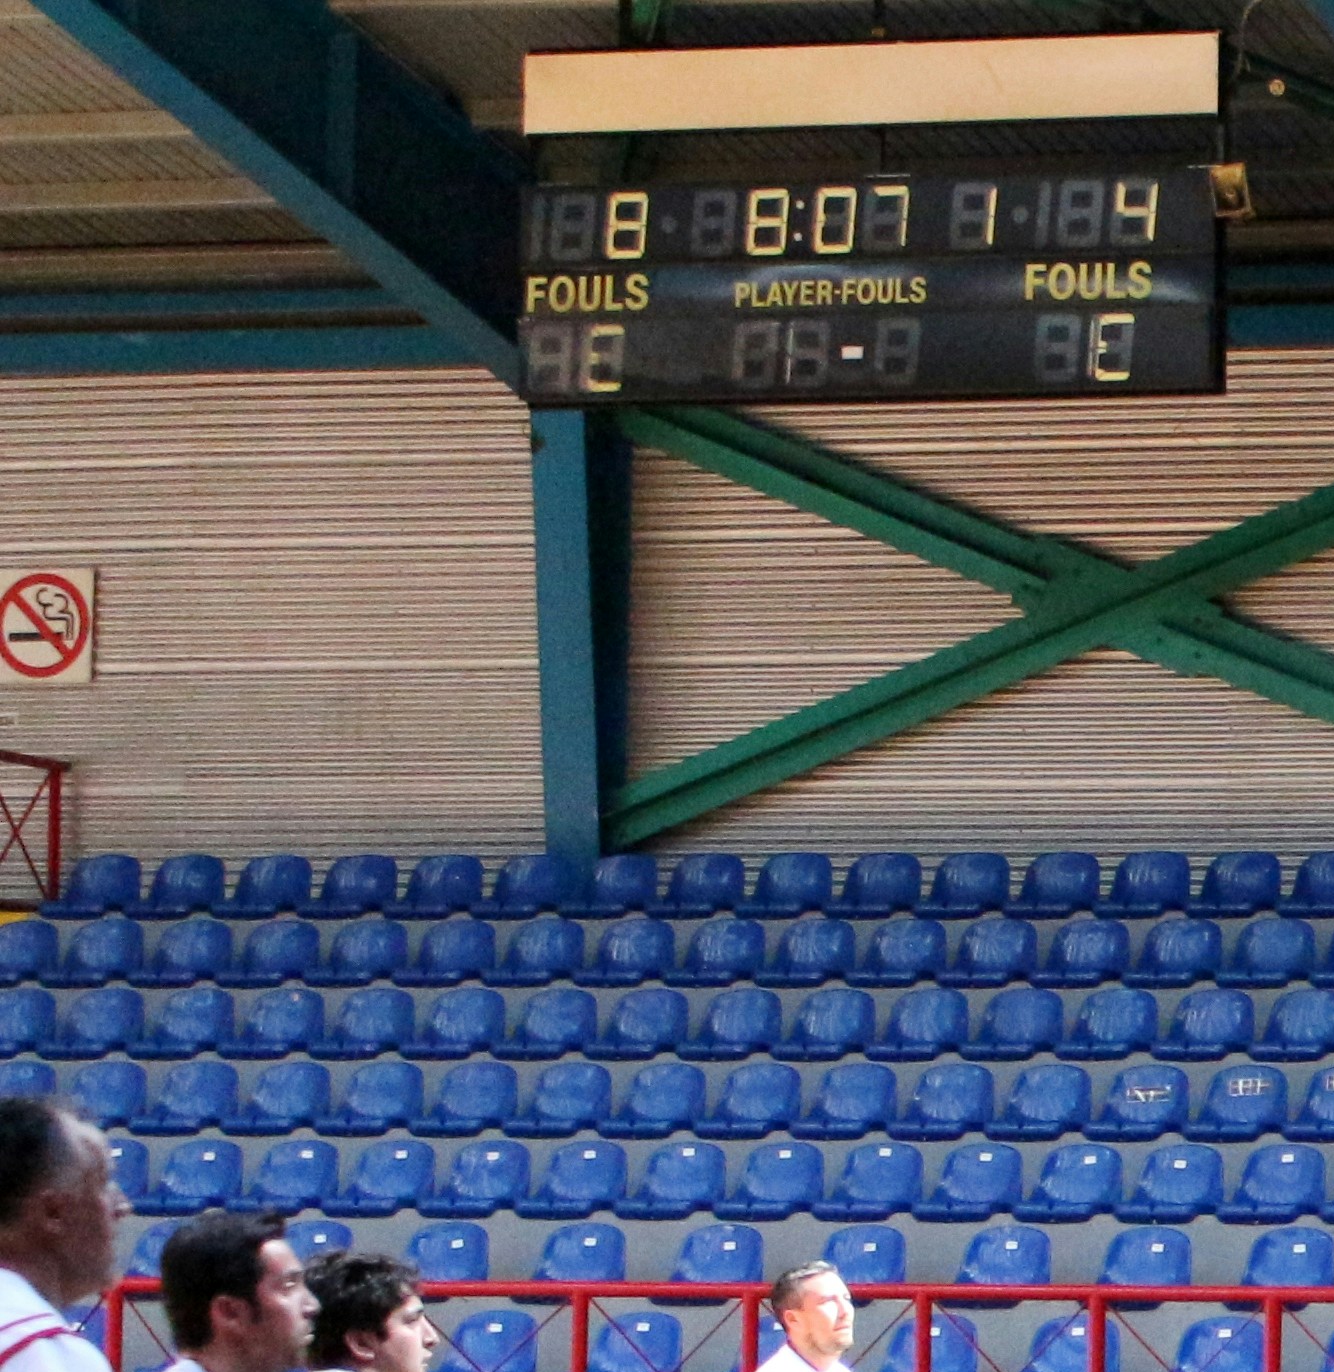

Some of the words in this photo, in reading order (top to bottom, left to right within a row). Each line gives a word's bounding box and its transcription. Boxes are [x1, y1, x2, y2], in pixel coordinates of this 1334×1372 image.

[525, 274, 650, 313] FOULS
[734, 276, 927, 308] PLAYER-FOULS
[1024, 260, 1153, 301] FOULS
